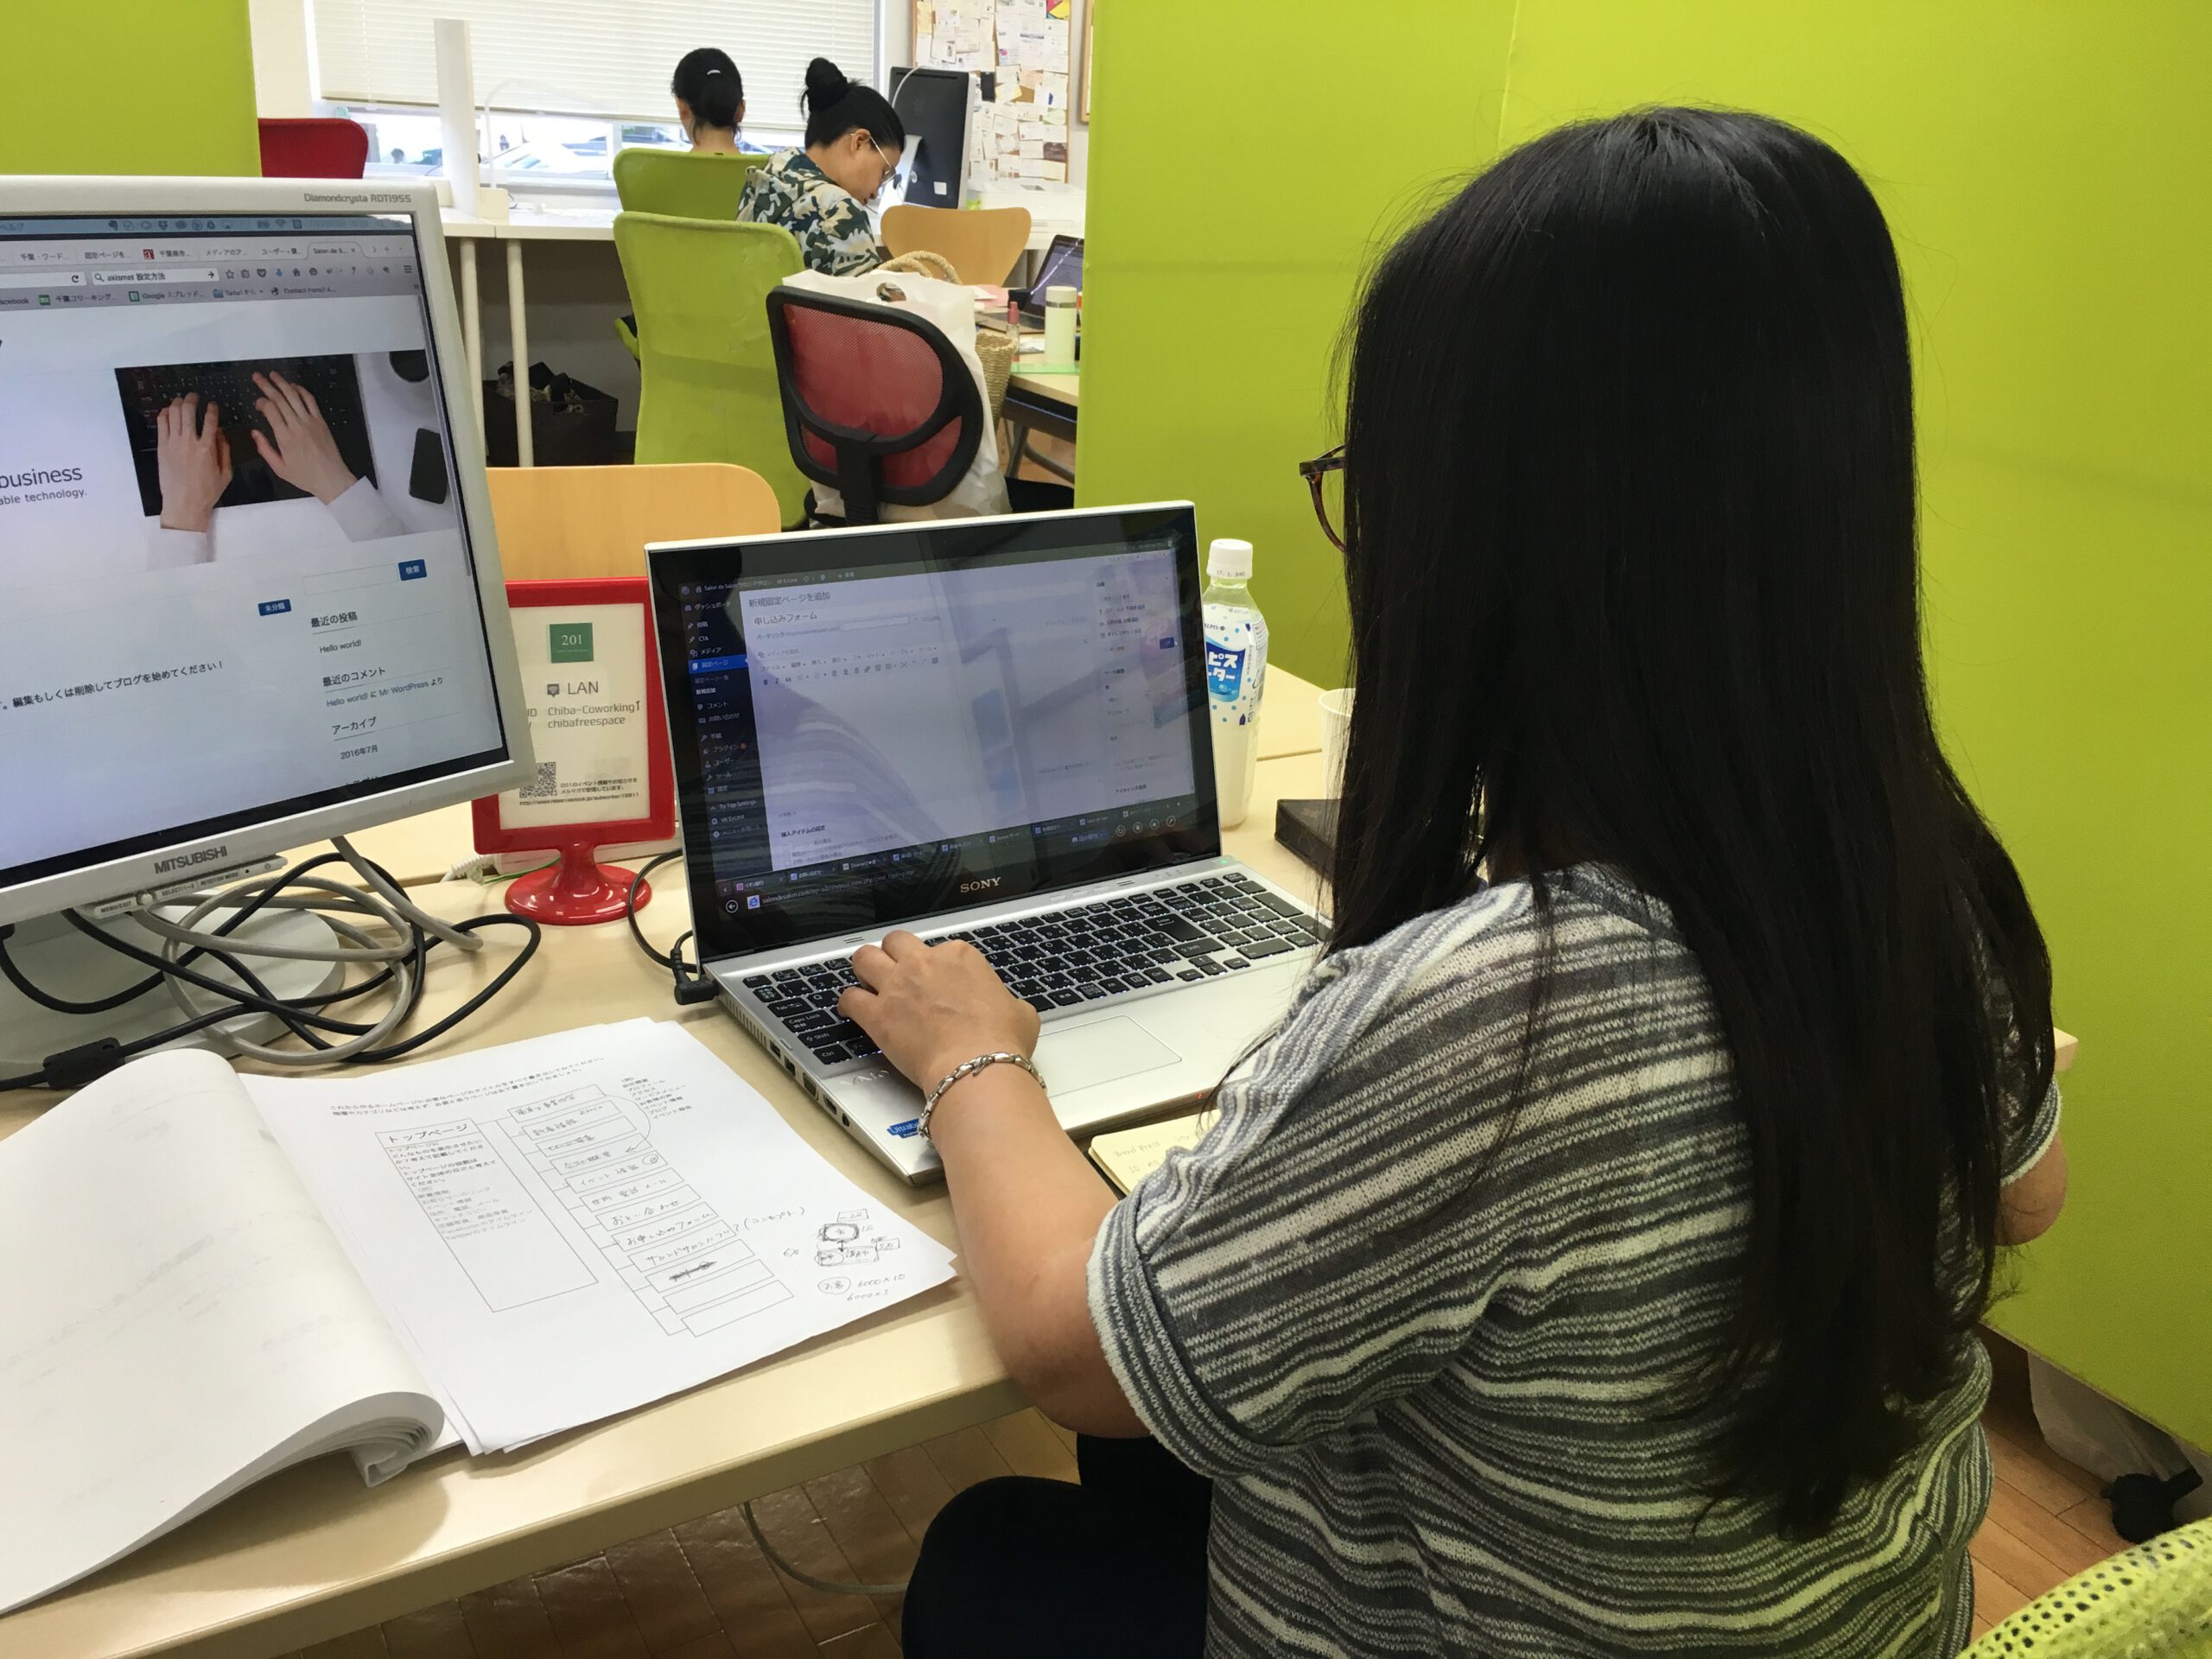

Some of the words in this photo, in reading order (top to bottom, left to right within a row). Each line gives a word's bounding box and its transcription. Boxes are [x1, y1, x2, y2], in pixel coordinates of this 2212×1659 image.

[303, 193, 368, 204] Diamondcrysta
[107, 274, 135, 283] akismet
[137, 272, 166, 281] 設定方法
[143, 292, 165, 301] Google
[25, 488, 87, 504] technology.
[748, 591, 831, 608] 新規固定ページを追加
[310, 611, 358, 628] 最近の投稿
[753, 612, 817, 626] 申し込みフォーム
[319, 643, 339, 654] Hello
[340, 639, 362, 650] world!
[562, 634, 582, 646] 201
[322, 666, 386, 687] 最近のコメント
[1208, 668, 1236, 682] ター
[327, 697, 346, 708] Hello
[346, 691, 369, 703] world!
[391, 680, 429, 695] WordPress
[430, 677, 443, 687] より
[568, 680, 600, 696] LAN
[707, 701, 728, 709] コメント
[332, 715, 377, 734] アーカイブ
[548, 716, 626, 729] chibafreespace
[340, 744, 378, 760] 2016年7月
[154, 845, 228, 874] MITSUBISHI
[960, 876, 1002, 895] SONY
[389, 1123, 468, 1144] トップページ
